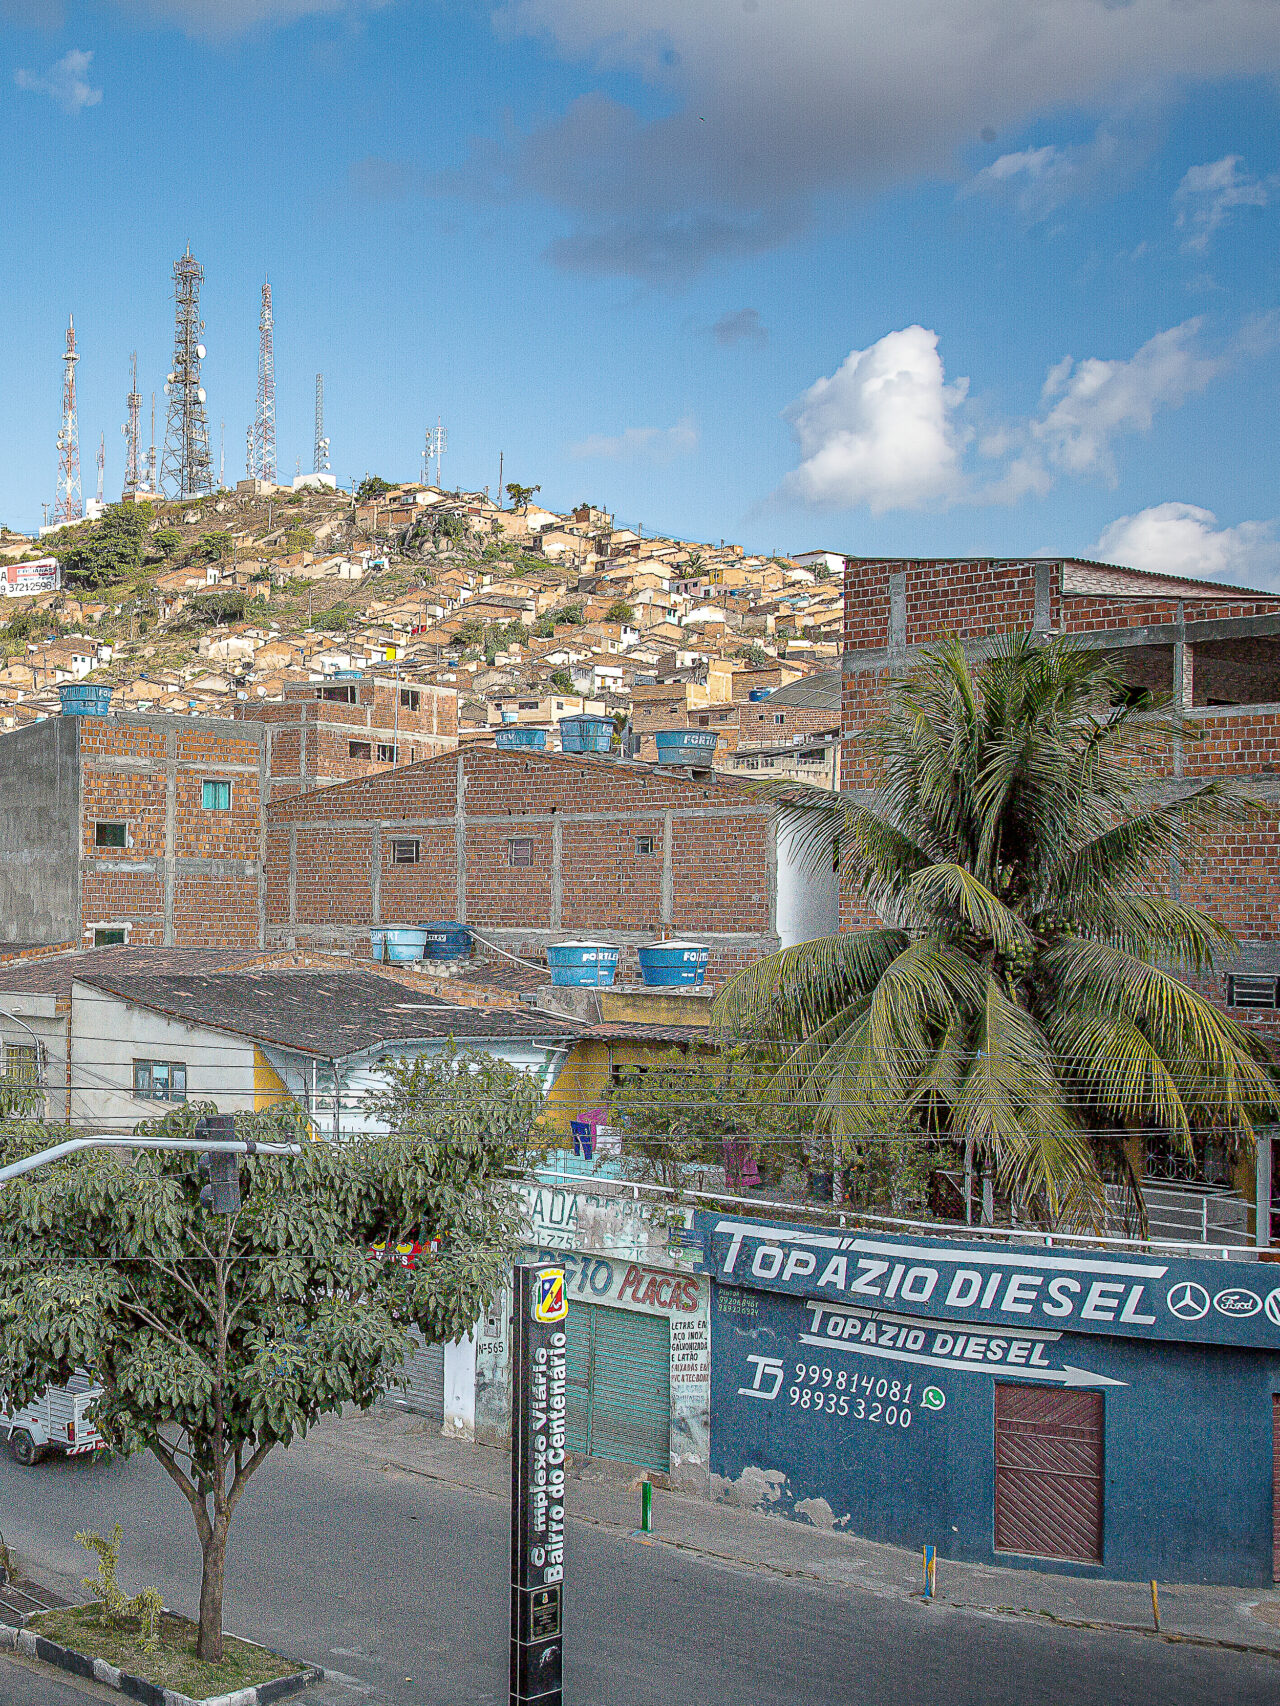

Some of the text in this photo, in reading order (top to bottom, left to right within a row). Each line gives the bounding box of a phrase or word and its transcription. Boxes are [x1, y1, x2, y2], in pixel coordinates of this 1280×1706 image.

[617, 1264, 701, 1314] PLACAS
[944, 1269, 1156, 1325] DIESEL
[1220, 1295, 1254, 1310] Ford
[671, 1320, 695, 1330] LETRAS
[677, 1351, 699, 1361] LATÃO
[931, 1333, 1051, 1366] DIESEL
[532, 1347, 548, 1431] Viário
[547, 1332, 567, 1465] Centenário
[794, 1362, 913, 1404] 999814081
[789, 1386, 912, 1428] 989353200
[546, 1468, 565, 1499] do
[543, 1504, 564, 1583] Bairro
